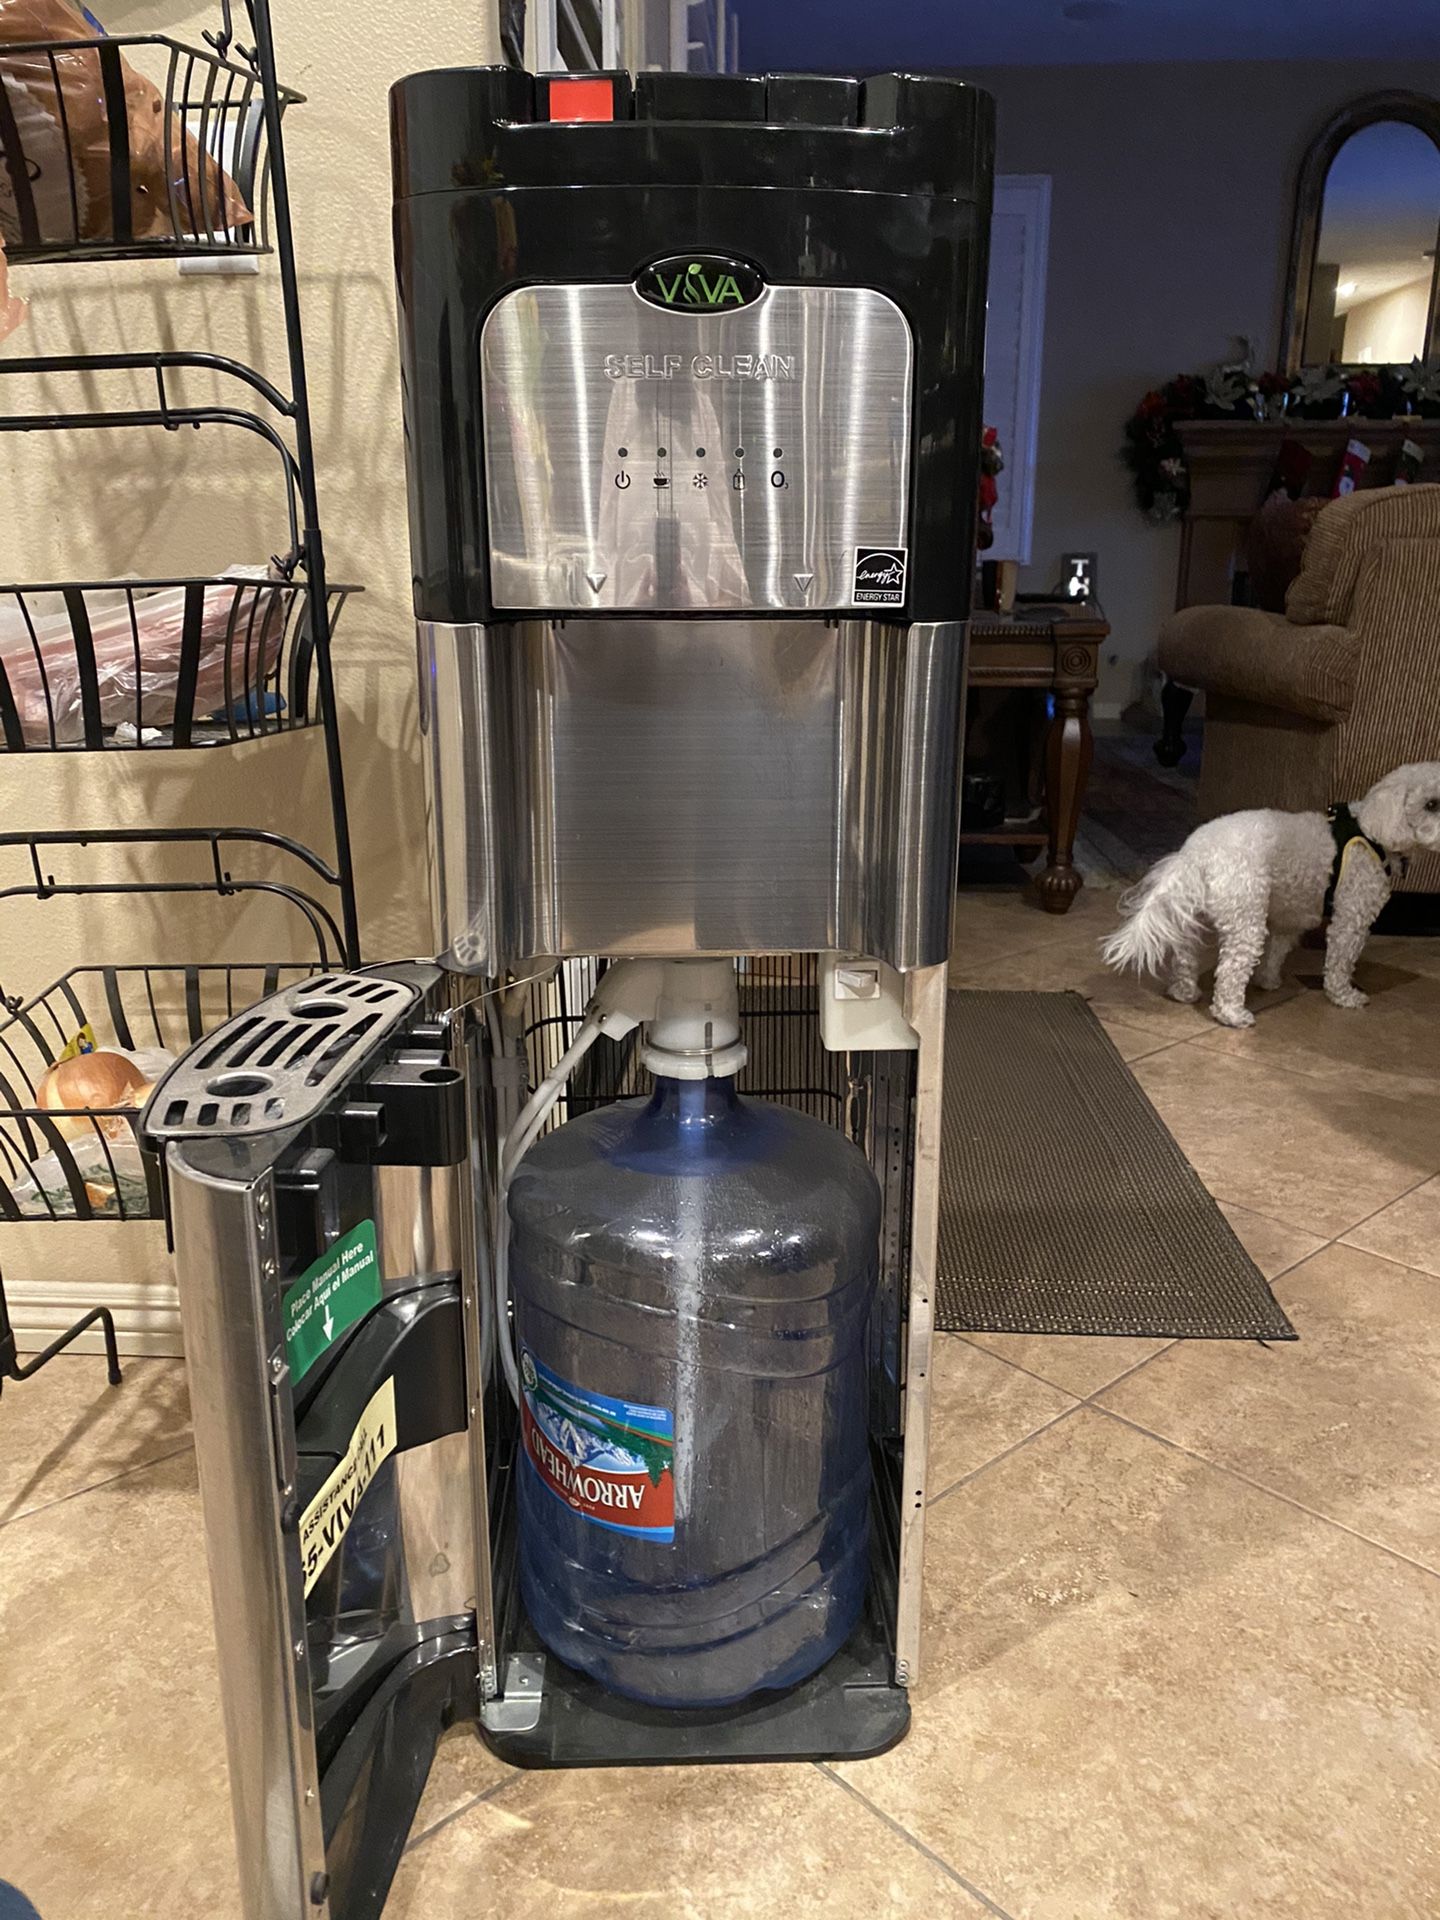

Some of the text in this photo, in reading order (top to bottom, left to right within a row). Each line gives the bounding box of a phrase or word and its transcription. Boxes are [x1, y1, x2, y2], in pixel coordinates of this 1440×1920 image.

[656, 263, 745, 304] VIVA
[604, 354, 796, 380] SELF CLEAN
[856, 592, 900, 602] ENERGY STAR
[312, 1257, 340, 1293] Manual
[341, 1243, 364, 1265] Here
[332, 1275, 340, 1291] el
[341, 1250, 374, 1283] Manual
[531, 1428, 646, 1510] ARROWHEAD
[302, 1457, 357, 1545] ASSISTANCE
